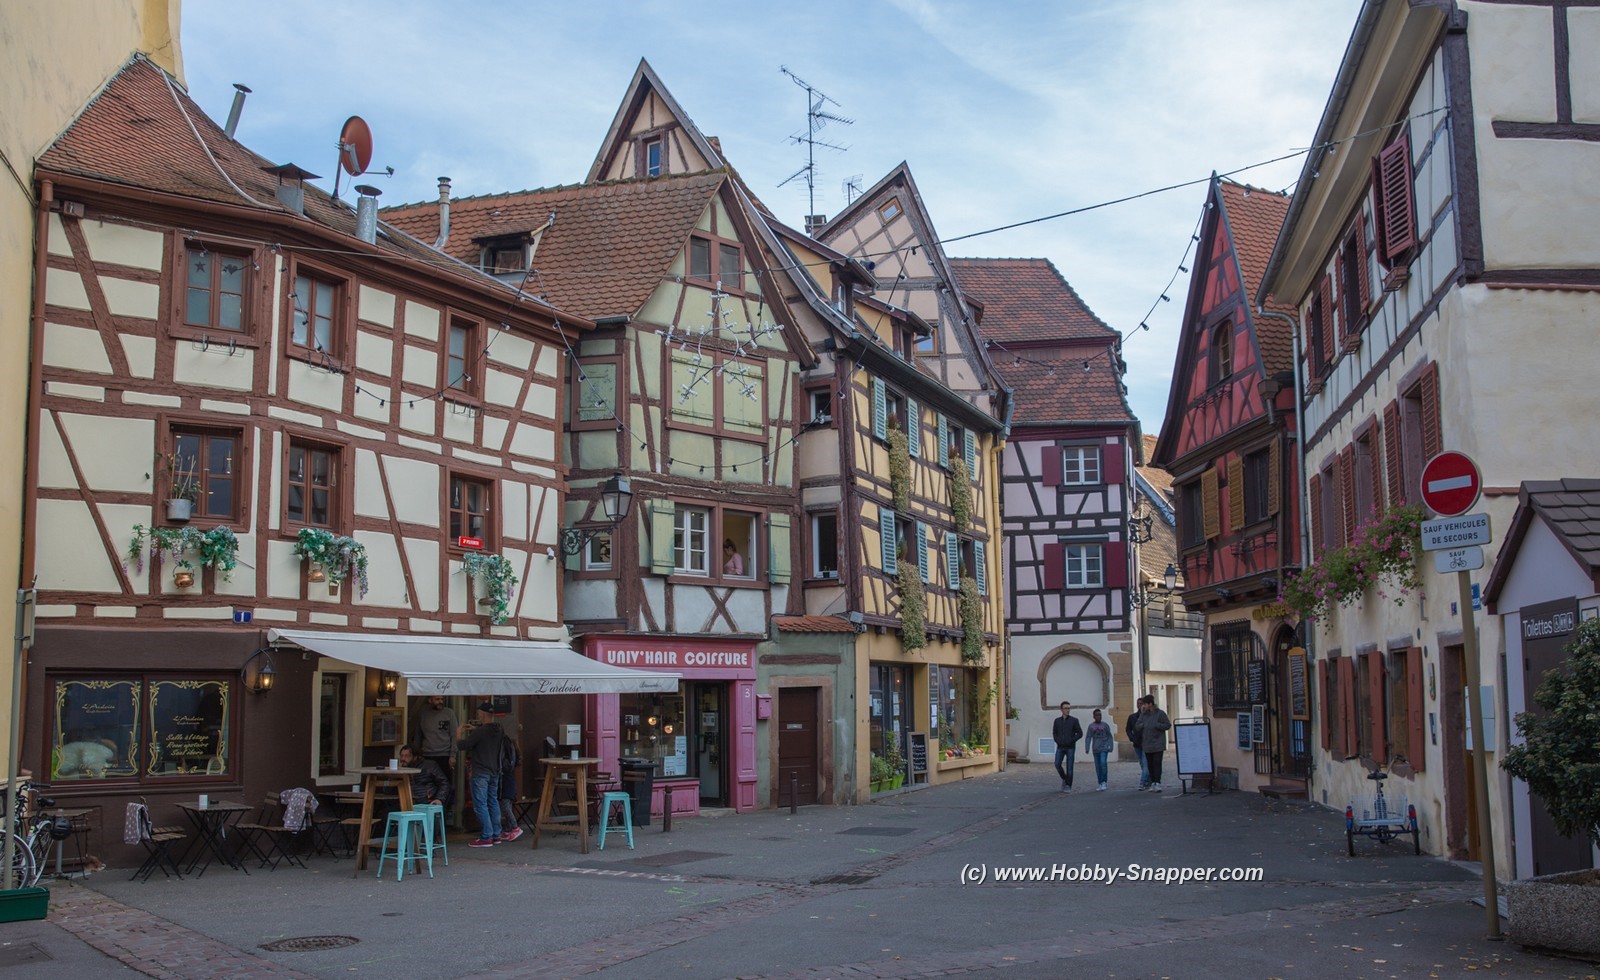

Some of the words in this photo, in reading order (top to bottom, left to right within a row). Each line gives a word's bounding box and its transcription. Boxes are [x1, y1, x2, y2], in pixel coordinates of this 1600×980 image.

[1423, 526, 1443, 534] SAUF
[1444, 519, 1487, 531] VEHICULES
[1431, 536, 1442, 545] DE
[1443, 532, 1479, 543] SECOURS
[1449, 550, 1466, 558] SAUF
[1522, 618, 1553, 638] Toilettes
[607, 650, 677, 665] UNIV'HAIR
[684, 652, 748, 665] COIFFURE
[536, 680, 582, 694] L'ardoise
[744, 688, 751, 699] 3
